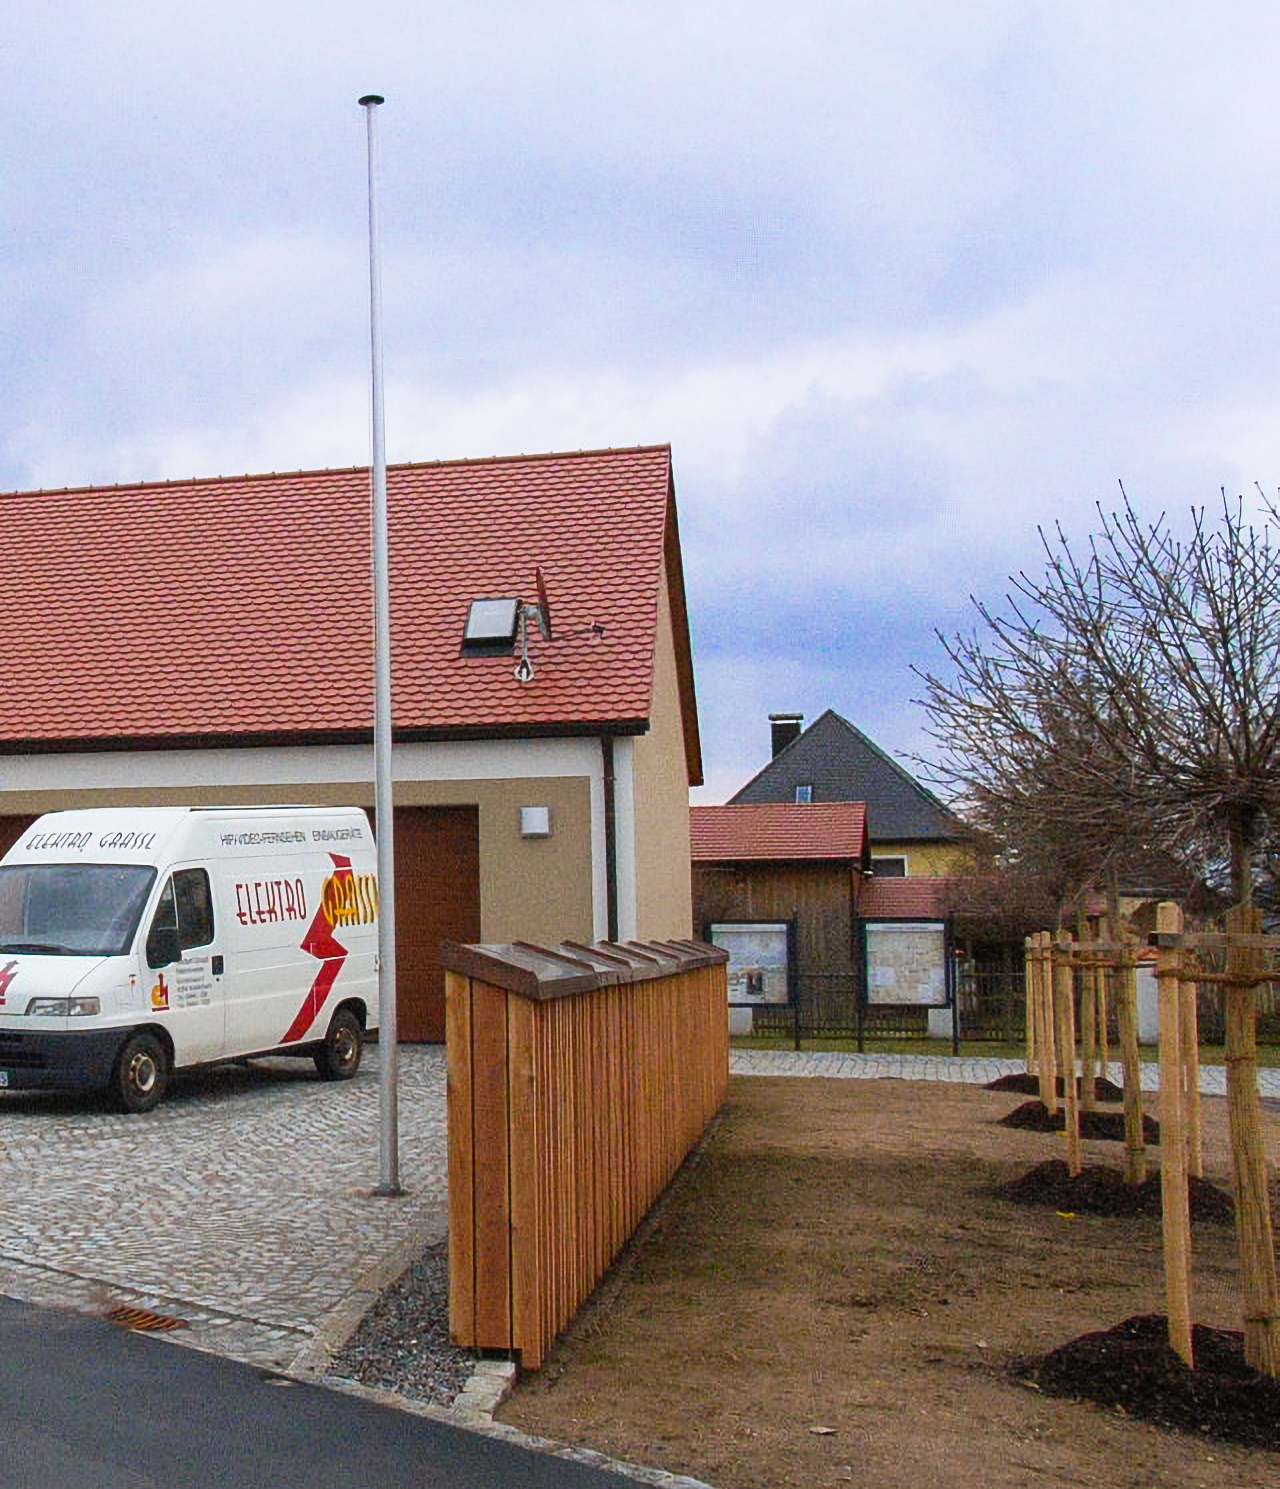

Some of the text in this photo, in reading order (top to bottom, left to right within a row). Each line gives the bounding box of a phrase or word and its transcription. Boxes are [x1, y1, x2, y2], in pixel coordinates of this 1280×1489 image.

[25, 831, 157, 852] ELEKTRO GRASSL
[235, 878, 307, 926] ELEKTRO
